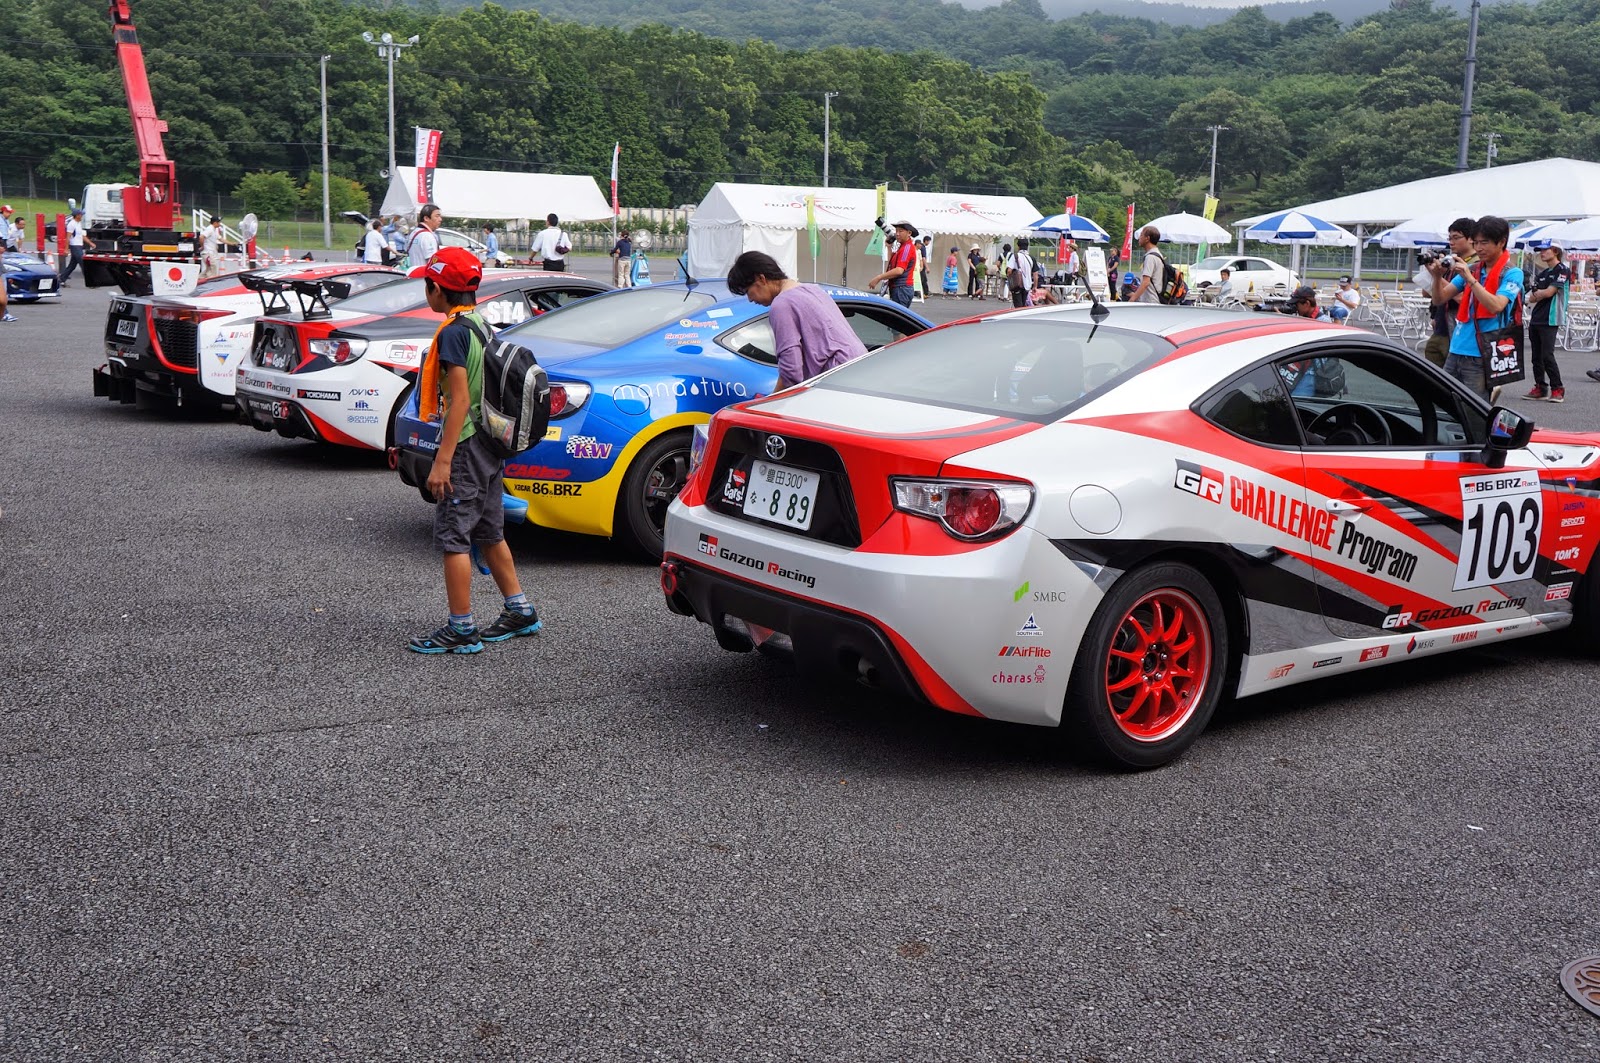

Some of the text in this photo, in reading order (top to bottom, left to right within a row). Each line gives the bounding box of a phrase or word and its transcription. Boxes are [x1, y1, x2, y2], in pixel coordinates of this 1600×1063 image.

[487, 301, 525, 323] ST4
[1490, 342, 1497, 357] I
[1490, 352, 1518, 371] Cars!
[1280, 368, 1299, 382] ars!
[266, 381, 291, 396] Racing
[306, 391, 339, 400] YOKOHAMA
[728, 468, 734, 482] I
[724, 483, 745, 502] Cars!
[1175, 468, 1418, 583] GR CHALLENGE Program
[1467, 497, 1540, 582] 103
[1554, 547, 1580, 561] TOM'S
[699, 541, 816, 588] GR GAZOO Racing
[1033, 591, 1067, 602] SMBC
[1382, 596, 1526, 629] GR GAZOO Racing
[1452, 630, 1478, 644] YAMAHA
[1012, 646, 1051, 657] AirFlite
[1417, 640, 1434, 649] MSIG
[992, 671, 1032, 683] charas
